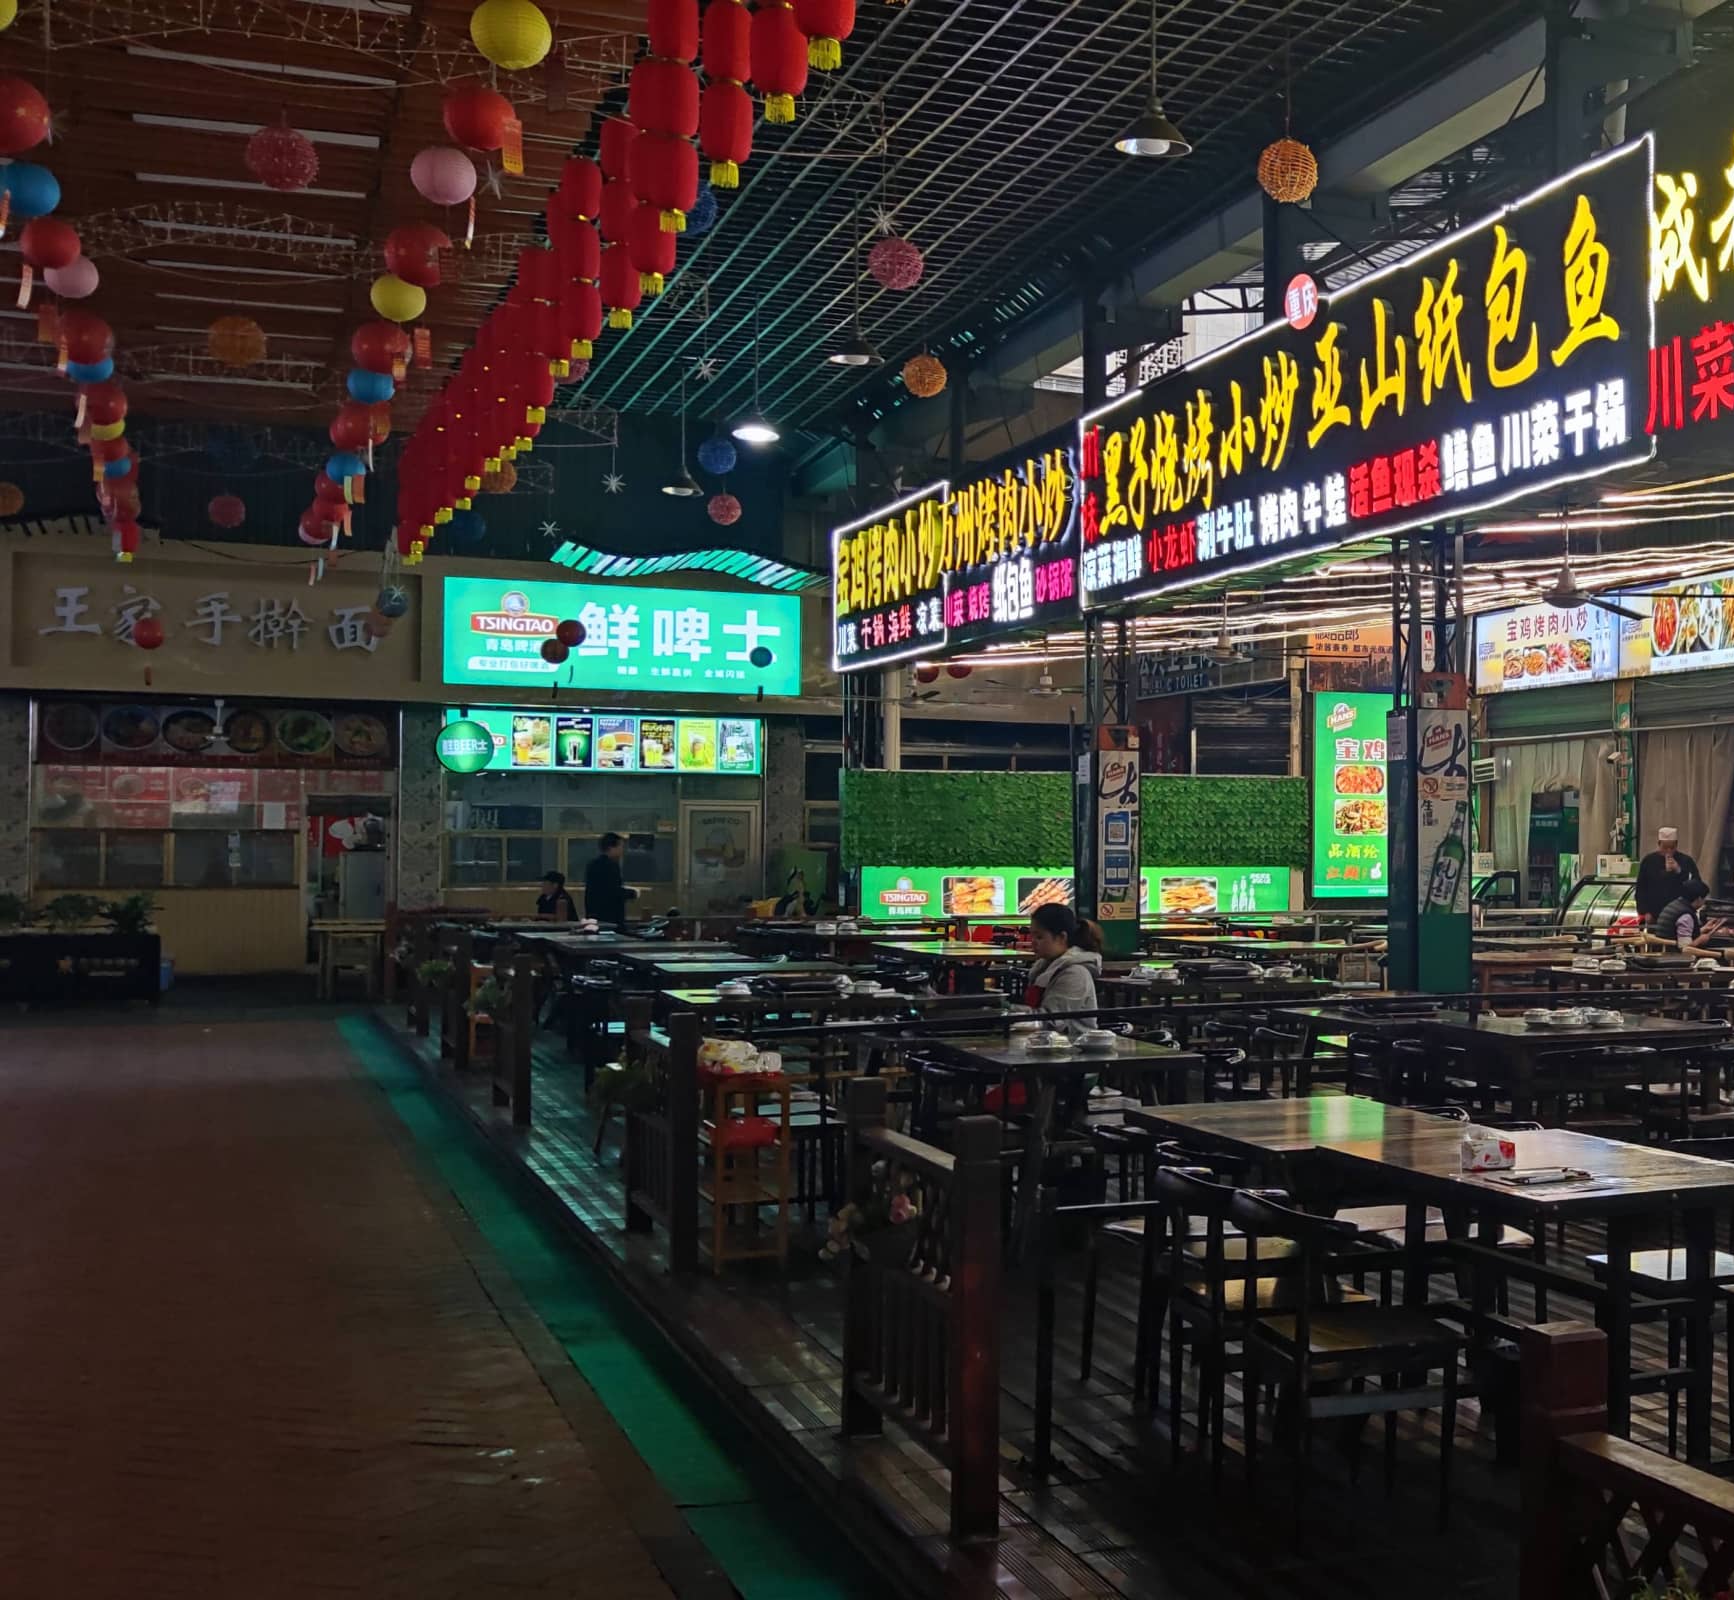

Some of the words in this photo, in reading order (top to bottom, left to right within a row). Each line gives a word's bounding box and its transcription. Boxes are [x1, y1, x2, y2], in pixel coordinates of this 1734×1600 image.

[1287, 281, 1317, 323] 重庆
[938, 448, 1066, 573] 万州烤肉小炒
[1147, 520, 1197, 573] 小龙虾
[1196, 498, 1255, 562] 涮牛肚
[1258, 487, 1299, 546] 烤肉
[1302, 471, 1348, 535] 牛蛙
[1349, 439, 1442, 519] 活鱼现杀
[943, 589, 965, 628] 川菜
[967, 581, 991, 622] 烧烤
[992, 556, 1034, 623] 纸包鱼
[1035, 557, 1074, 603] 砂锅粥
[38, 584, 385, 653] 王家手擀面
[475, 616, 554, 634] TSINGTAO
[578, 601, 782, 662] 鲜啤士
[837, 621, 860, 656] 川菜
[860, 612, 885, 651] 干锅
[888, 604, 912, 643] 海鲜
[1506, 606, 1589, 643] 宝鸡烤肉小炒
[1175, 672, 1204, 690] TOILET
[1329, 710, 1355, 726] HANS
[1335, 738, 1387, 761] 宝鸡
[883, 893, 927, 903] TSINGTAO
